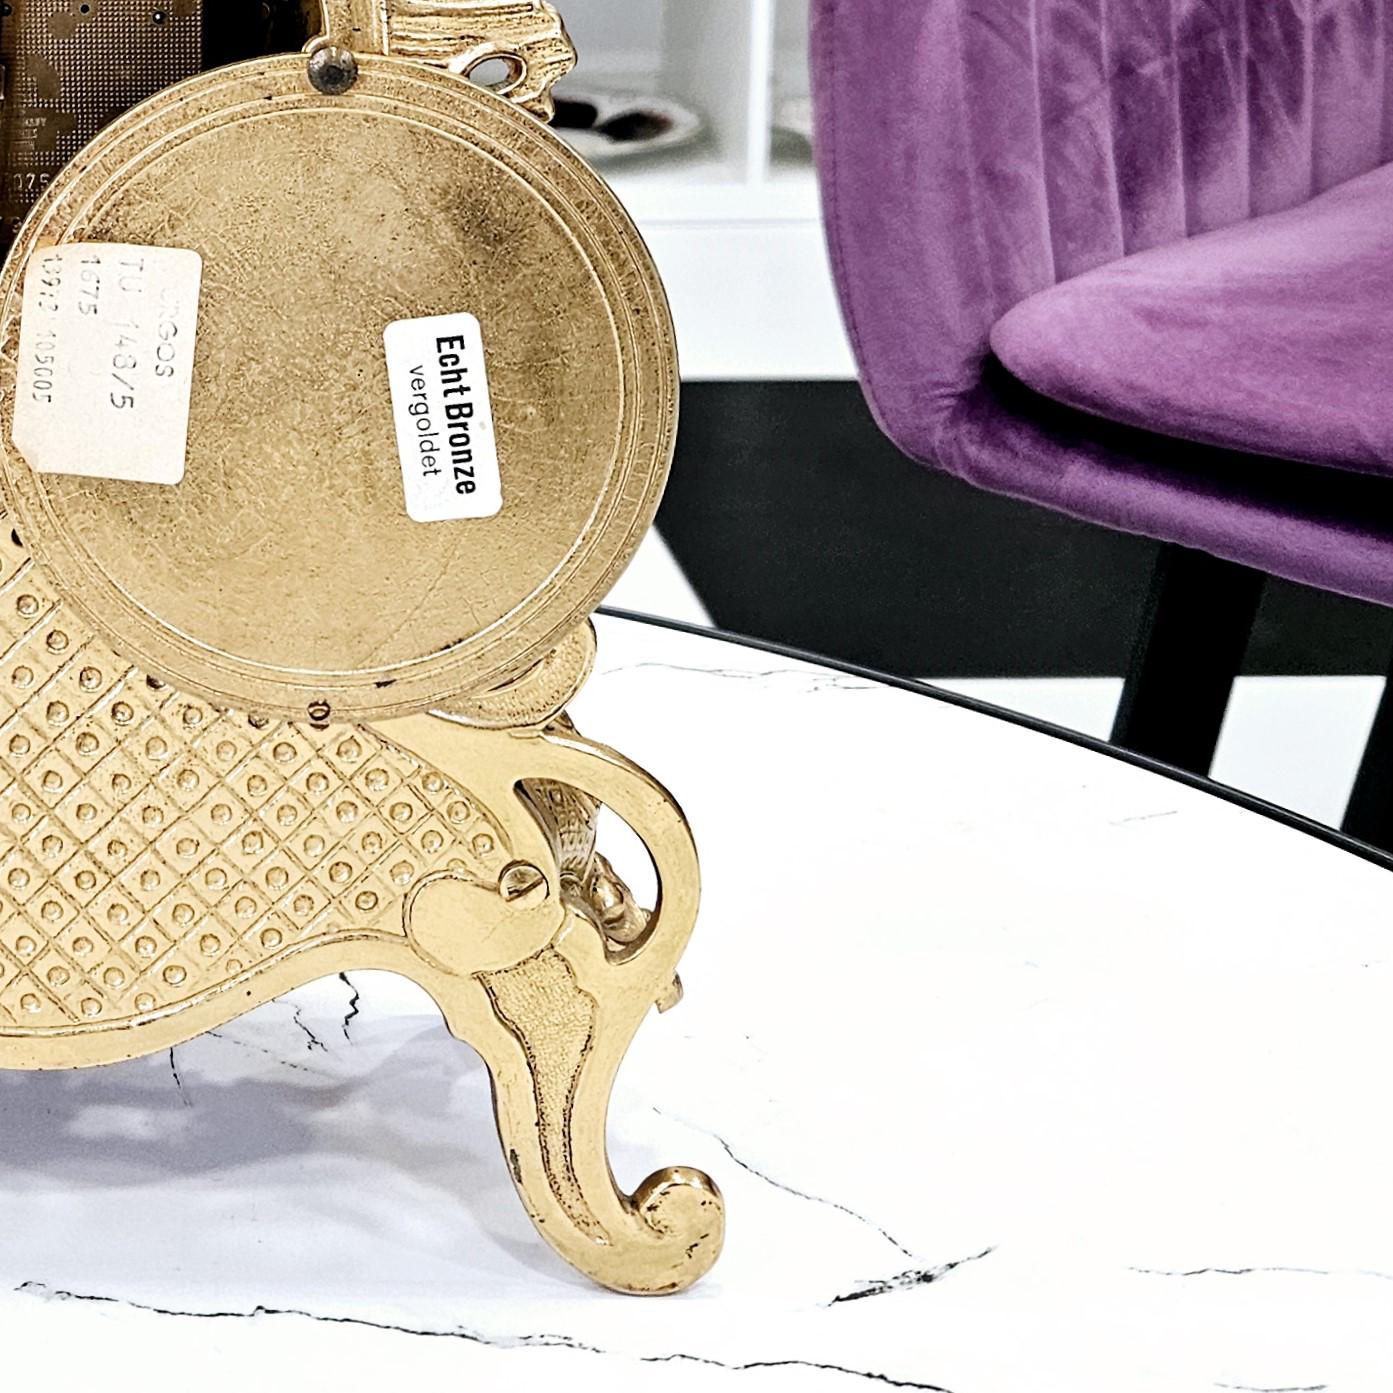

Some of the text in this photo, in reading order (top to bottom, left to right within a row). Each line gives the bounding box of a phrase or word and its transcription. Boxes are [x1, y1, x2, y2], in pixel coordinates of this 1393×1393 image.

[77, 254, 102, 316] 1675
[409, 365, 442, 477] vergoldet
[436, 334, 477, 495] Echt Bronze
